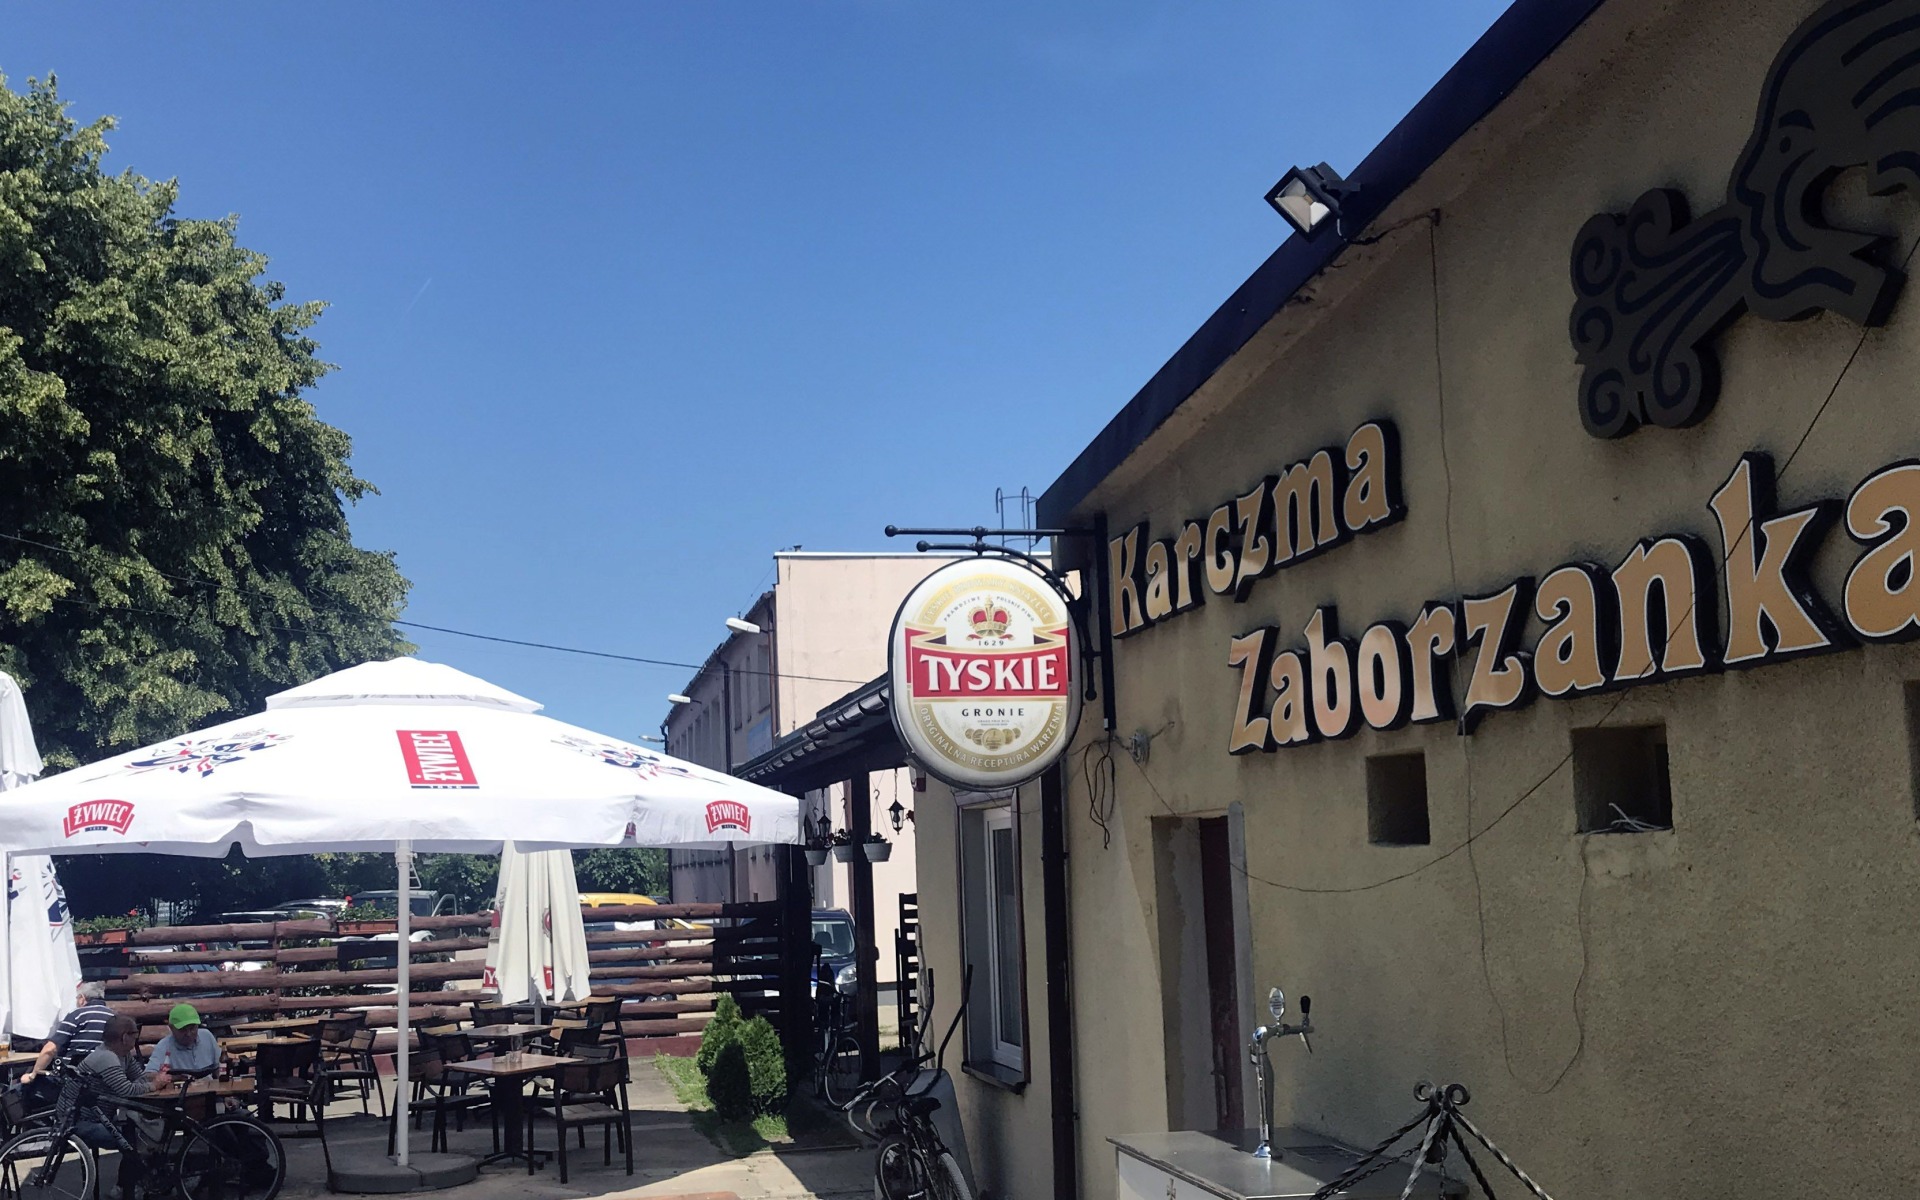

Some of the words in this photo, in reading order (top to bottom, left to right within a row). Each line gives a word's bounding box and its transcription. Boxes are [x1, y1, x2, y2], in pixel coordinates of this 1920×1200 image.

[1108, 421, 1398, 637] Karczma
[996, 595, 1021, 609] POLSKIE
[1020, 607, 1035, 622] PIWO
[1228, 456, 1920, 754] Zaborzanka
[919, 653, 1060, 692] TYSKIE
[961, 708, 1025, 717] GRONIE
[920, 707, 967, 762] ORYGINALNA
[970, 750, 1031, 768] RECEPTURA
[1030, 704, 1064, 753] WARZENIA
[411, 733, 464, 781] ŻYWIEC
[73, 802, 129, 826] ŻYWIEC
[710, 803, 746, 823] ŻYWIEC
